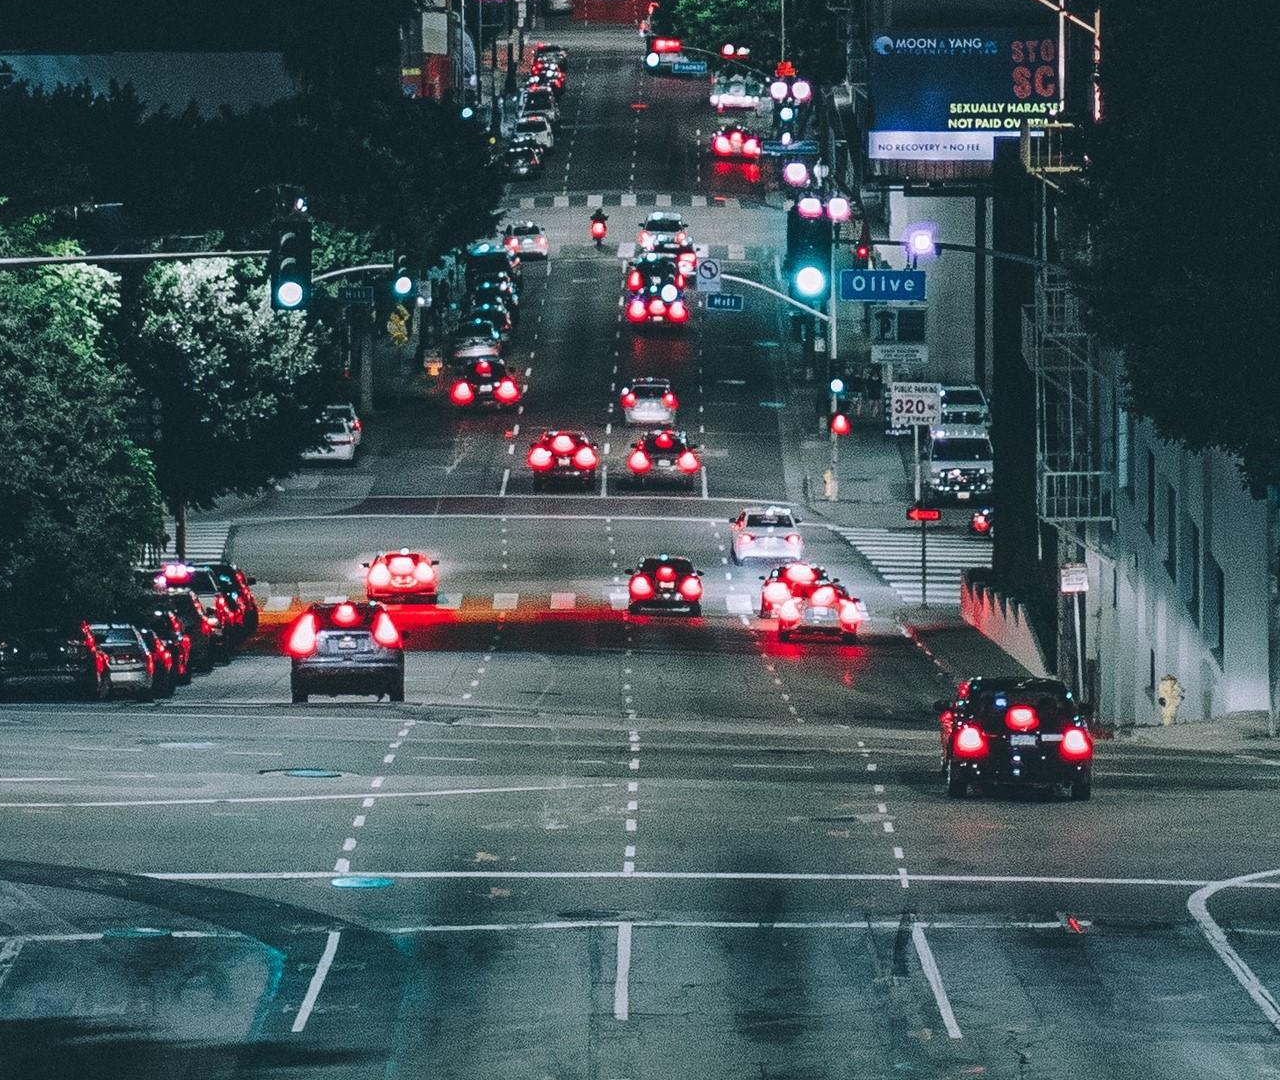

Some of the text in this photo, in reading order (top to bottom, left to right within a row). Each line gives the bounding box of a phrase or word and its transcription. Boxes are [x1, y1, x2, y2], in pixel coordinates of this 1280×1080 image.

[895, 38, 937, 49] MOON
[948, 37, 982, 49] YANG
[949, 103, 1061, 114] SEXUALLY HARASE
[948, 118, 973, 128] NOT
[975, 118, 1002, 128] PAID
[878, 143, 981, 152] NO RECOVERY NO FEE
[852, 275, 915, 292] Olive
[894, 398, 926, 414] 320
